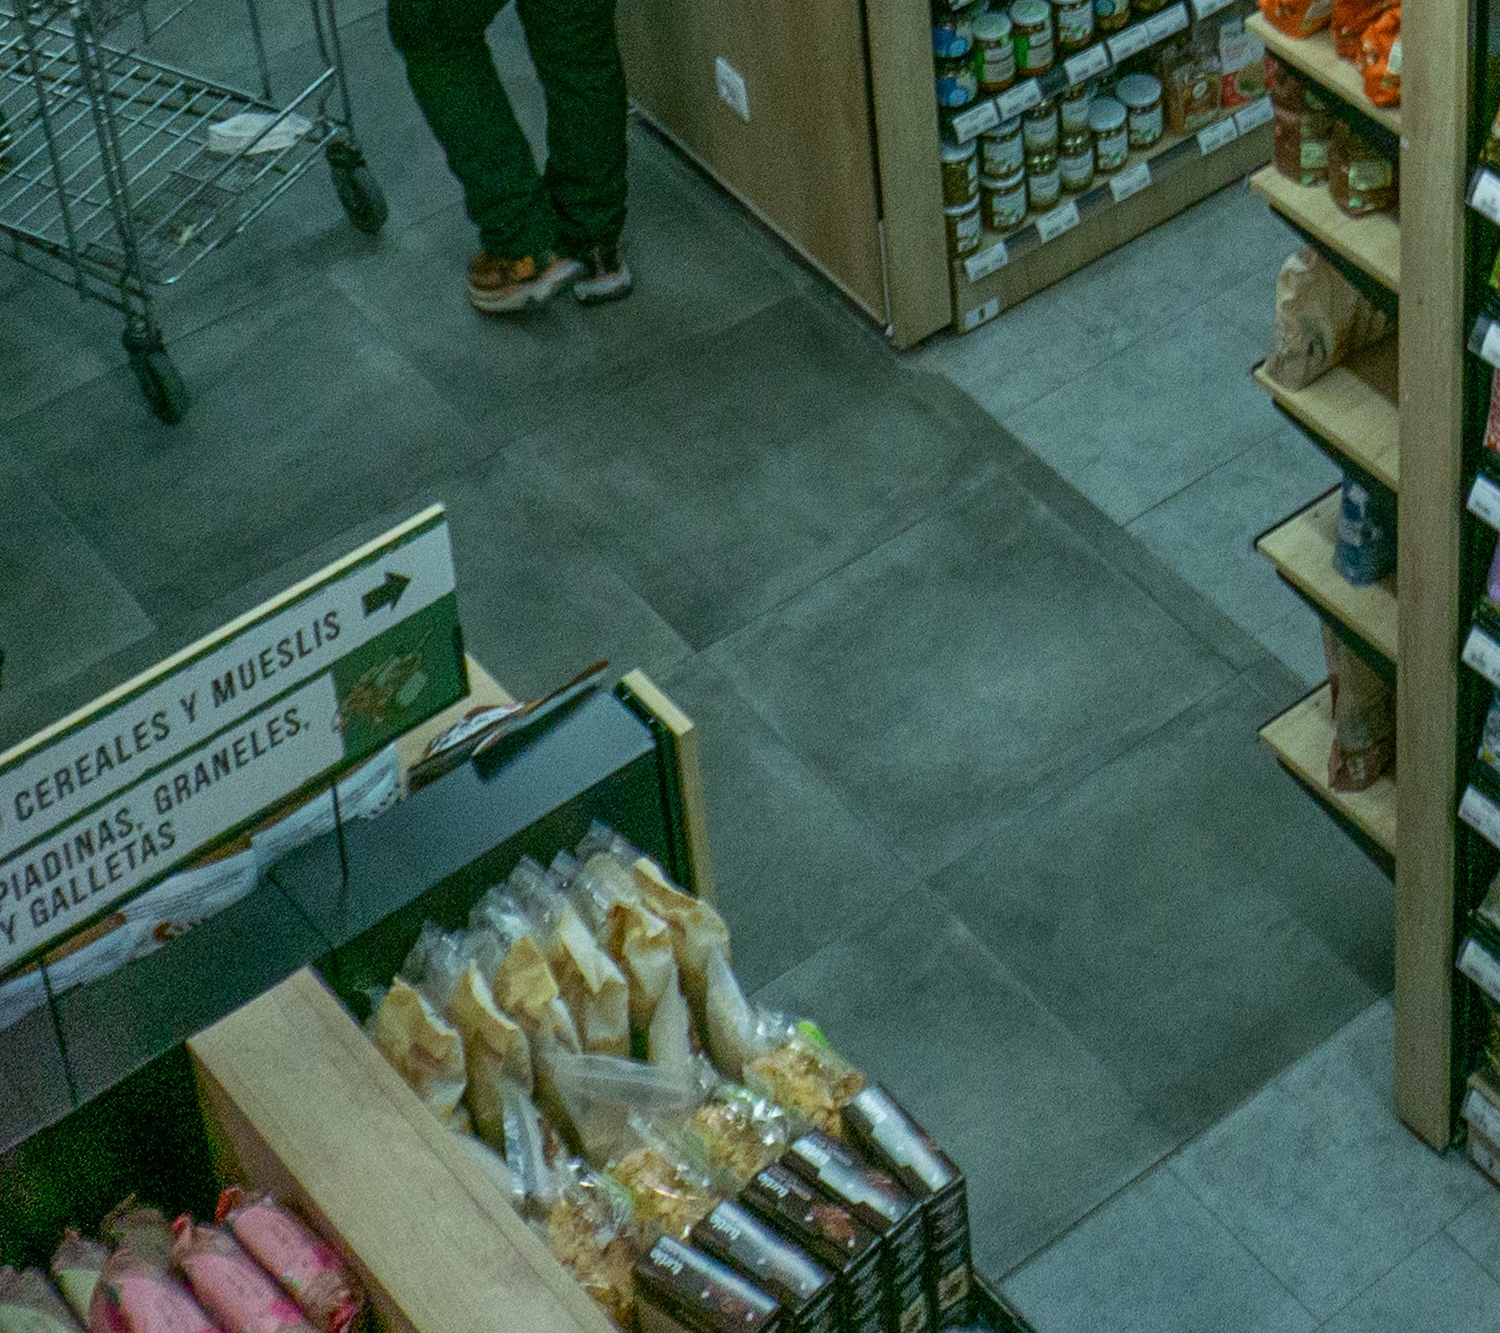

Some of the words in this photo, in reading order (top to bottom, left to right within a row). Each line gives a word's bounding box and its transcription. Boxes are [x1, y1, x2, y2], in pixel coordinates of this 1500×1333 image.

[12, 710, 172, 824] CEREALES
[179, 694, 200, 726] Y
[211, 609, 343, 710] MUESLIS
[155, 704, 312, 814] GRANELES,
[0, 914, 21, 946] Y
[28, 824, 177, 928] GALLETAS
